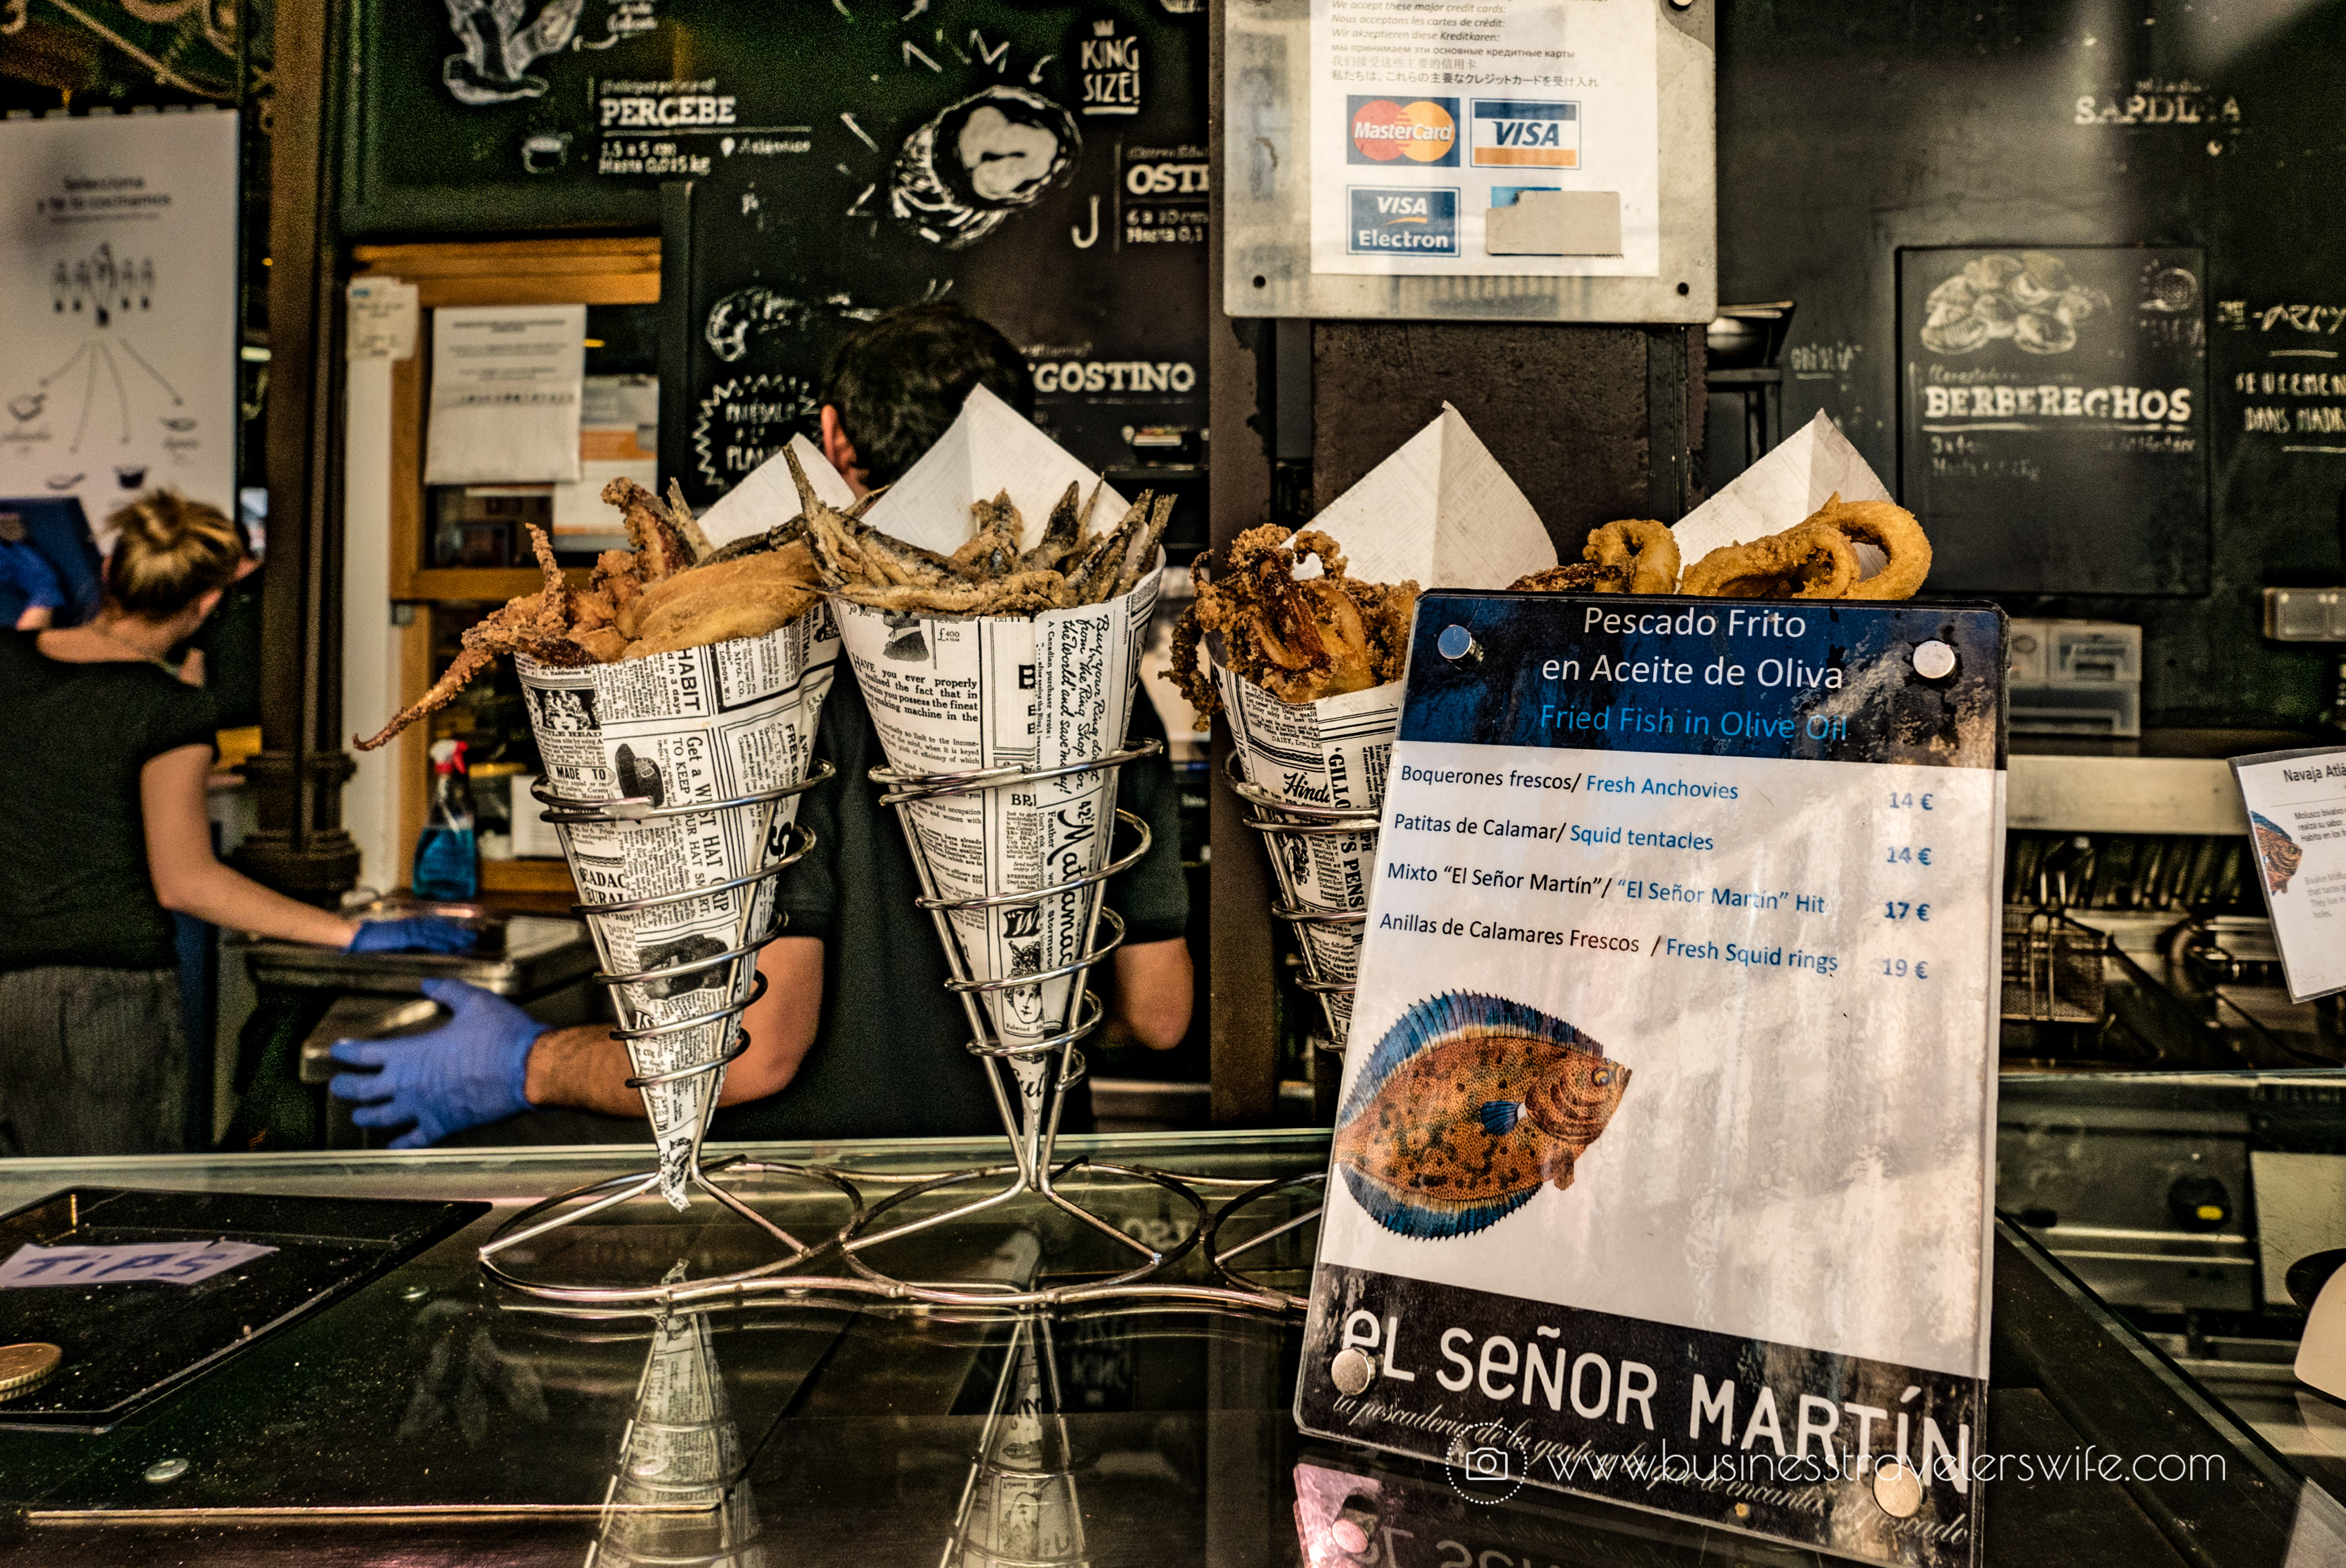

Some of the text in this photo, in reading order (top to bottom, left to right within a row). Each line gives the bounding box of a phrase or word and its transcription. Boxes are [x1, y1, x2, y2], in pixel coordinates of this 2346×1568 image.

[1332, 0, 1507, 14] We accept these major credit cards:
[1332, 14, 1356, 23] Nous
[1359, 16, 1409, 25] acceptons
[1411, 16, 1425, 25] les
[1428, 18, 1457, 27] cartes
[1460, 18, 1472, 27] de
[1332, 29, 1349, 37] Wir
[1352, 29, 1410, 40] akzeptieren
[1412, 30, 1438, 40] diese
[1081, 35, 1140, 70] KING
[1351, 45, 1411, 54] принимаем
[1433, 47, 1483, 56] основные
[1486, 48, 1542, 58] кредитные
[1545, 50, 1575, 59] карты
[1081, 71, 1141, 105] SIZE!
[599, 96, 736, 127] PERCEBE
[1354, 122, 1453, 142] MasterCard
[1493, 121, 1560, 147] VISA
[1376, 196, 1427, 215] VISA
[1358, 229, 1449, 248] Electron
[1027, 361, 1197, 393] GOSTINO
[1584, 606, 1806, 638] Pescado Frito
[677, 648, 701, 711] HABIT
[851, 652, 978, 690] HAVE you ever properly
[1541, 654, 1843, 690] en Aceite de Oliva
[668, 664, 675, 675] in
[672, 690, 682, 714] days
[884, 691, 979, 711] you possess the finest
[895, 682, 909, 692] the
[915, 685, 934, 696] fact
[940, 688, 962, 699] that
[967, 690, 978, 699] in
[1046, 670, 1054, 710] purchaser
[1073, 619, 1095, 757] from Ring Shop
[904, 706, 979, 723] machine in the
[1059, 690, 1075, 747] and save
[1090, 699, 1105, 736] Ring
[1540, 704, 1848, 741] Fried Fish in Olive Oil
[785, 724, 798, 765] FREE
[556, 766, 606, 780] MADE TO
[1401, 765, 1738, 800] Boquerones frescos/ Fresh Anchovies
[2283, 766, 2323, 783] Navaja
[673, 737, 703, 867] TO KEEP HAT
[686, 736, 723, 867] Get a HAT
[1889, 792, 1934, 811] 14 €
[2294, 808, 2343, 821] Molusco bivalvo
[1048, 810, 1056, 849] Feather
[1394, 814, 1714, 850] Patitas de Calamar/ Squid tentacles
[2300, 832, 2323, 842] Habita
[2332, 830, 2342, 838] los
[2327, 819, 2343, 828] sabor
[1886, 846, 1932, 866] 14 €
[1343, 858, 1366, 909] PENS
[1387, 863, 1438, 882] Mixto
[1472, 869, 1524, 889] Señor
[1648, 882, 1705, 904] Señor
[1711, 887, 1789, 910] Martín”
[1796, 894, 1825, 914] Hit
[1884, 901, 1931, 922] 17 €
[2310, 898, 2326, 909] They
[1379, 912, 1438, 935] Anillas
[1442, 917, 1464, 937] de
[1469, 921, 1564, 946] Calamares
[1569, 929, 1640, 953] Frescos
[1666, 938, 1719, 961] Fresh
[1726, 943, 1782, 967] Squid
[1788, 949, 1839, 975] rings
[1881, 957, 1929, 980] 19 €
[1689, 1374, 1969, 1494] MARTÍN
